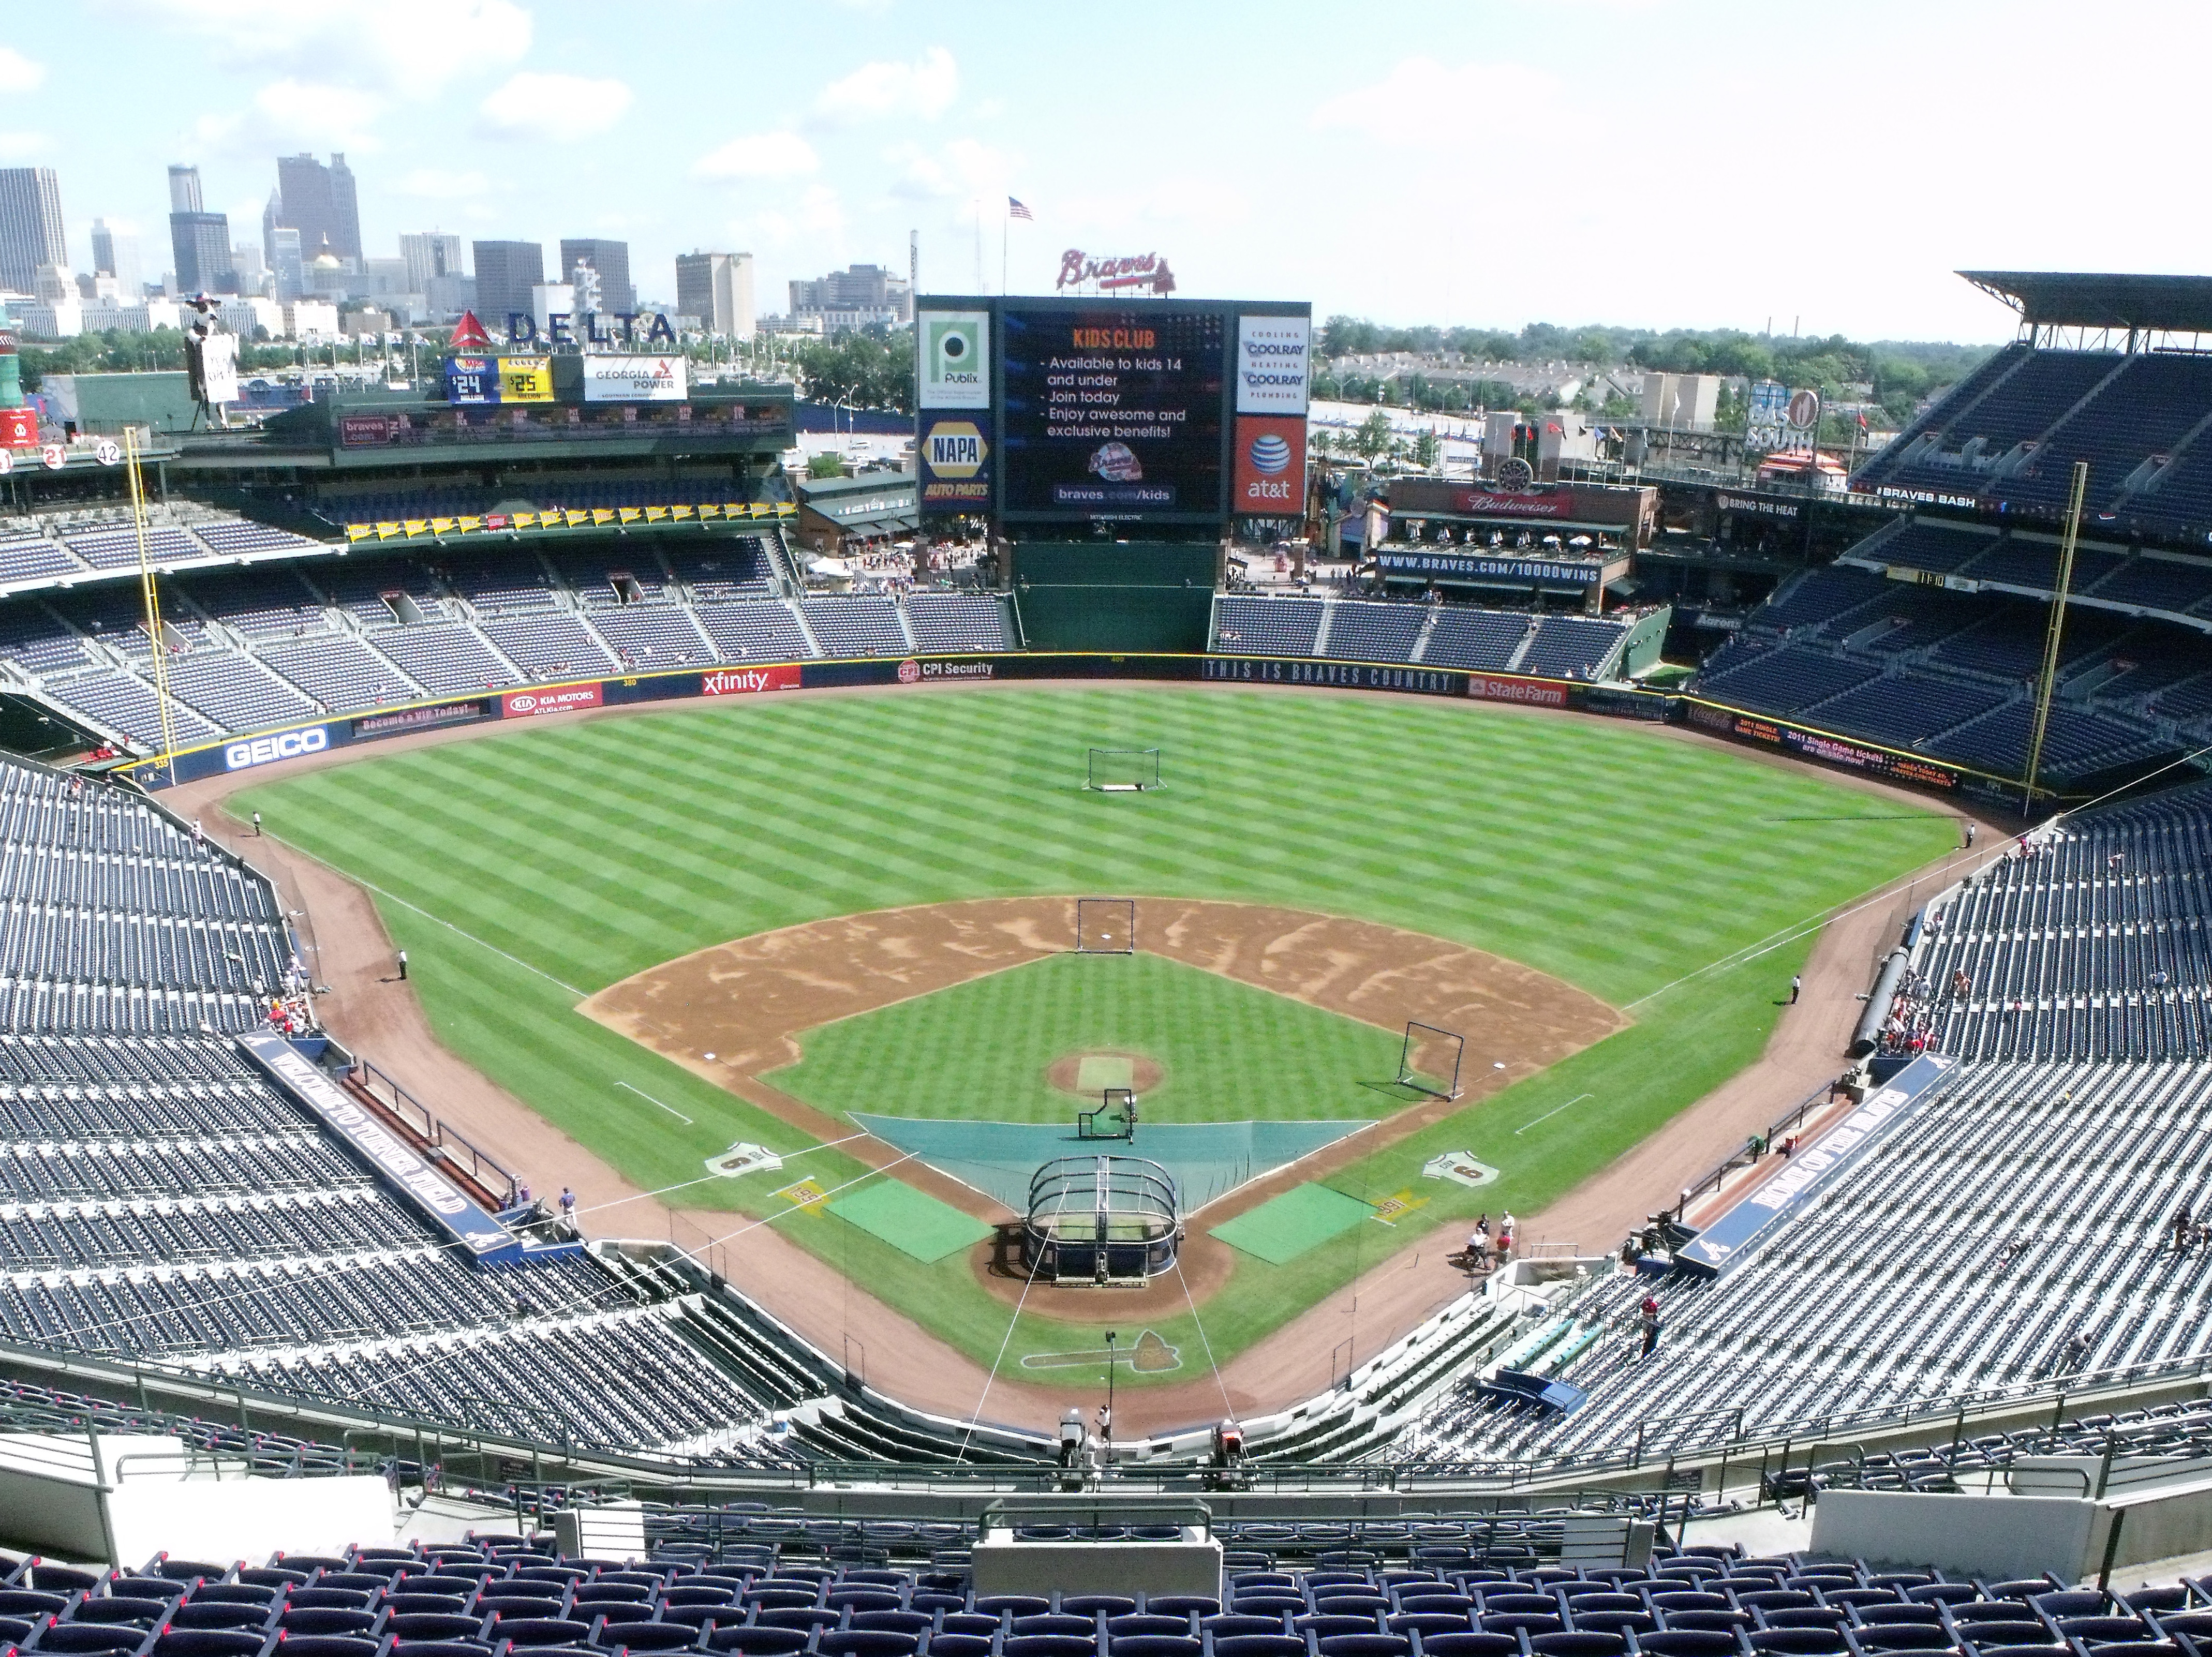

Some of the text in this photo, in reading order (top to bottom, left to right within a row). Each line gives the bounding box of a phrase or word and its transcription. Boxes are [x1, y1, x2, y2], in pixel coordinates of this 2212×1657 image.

[1057, 249, 1156, 291] Braves
[509, 314, 676, 342] DELTA
[1074, 329, 1155, 348] KIDS CLUB
[1248, 344, 1305, 354] COOLRAY
[1050, 357, 1182, 370] Available to kids 14
[596, 371, 649, 379] GEORGIA
[945, 373, 977, 383] Publix
[1048, 375, 1118, 386] and under
[1248, 375, 1304, 385] COOLRAY
[452, 376, 481, 394] $24
[510, 375, 536, 392] $25
[633, 380, 674, 389] POWER
[1049, 392, 1120, 405] Join today
[1049, 407, 1186, 422] Enjoy awesome and
[1749, 404, 1789, 427] GAS
[346, 421, 384, 431] braves
[1047, 426, 1171, 438] exclusive benefits!
[1745, 426, 1813, 452] SOUTH
[44, 448, 66, 465] 21
[98, 445, 118, 462] 42
[933, 438, 978, 462] NAPA
[925, 484, 988, 496] AUTO PARTS
[1248, 480, 1290, 498] at&t
[1468, 496, 1557, 512] Budweiser
[1730, 499, 1798, 517] BRING THE HEAT
[1939, 495, 1975, 507] BASH
[351, 528, 367, 536] 1969
[1379, 555, 1598, 582] WWW.BRAVES.COM/10000WINS
[1921, 572, 1944, 587] 11:10
[923, 663, 942, 675] CPI
[945, 662, 993, 675] Security
[1209, 660, 1449, 691] THIS IS BRAVES COUNTRY
[623, 678, 637, 686] 380
[704, 670, 768, 695] xfinity
[515, 691, 594, 709] KIA KIA MOTORS
[227, 728, 326, 768] GEICO
[1787, 731, 1883, 763] 2011 Single Game tickets
[1802, 744, 1815, 753] are
[155, 759, 169, 769] 335
[270, 1052, 468, 1214] WELCOME TO TURNER FIELD
[1750, 1088, 1909, 1211] HOME OF THE BRAVES
[721, 1157, 751, 1170] 6
[1439, 1160, 1457, 1170] COX
[1453, 1166, 1484, 1180] 6
